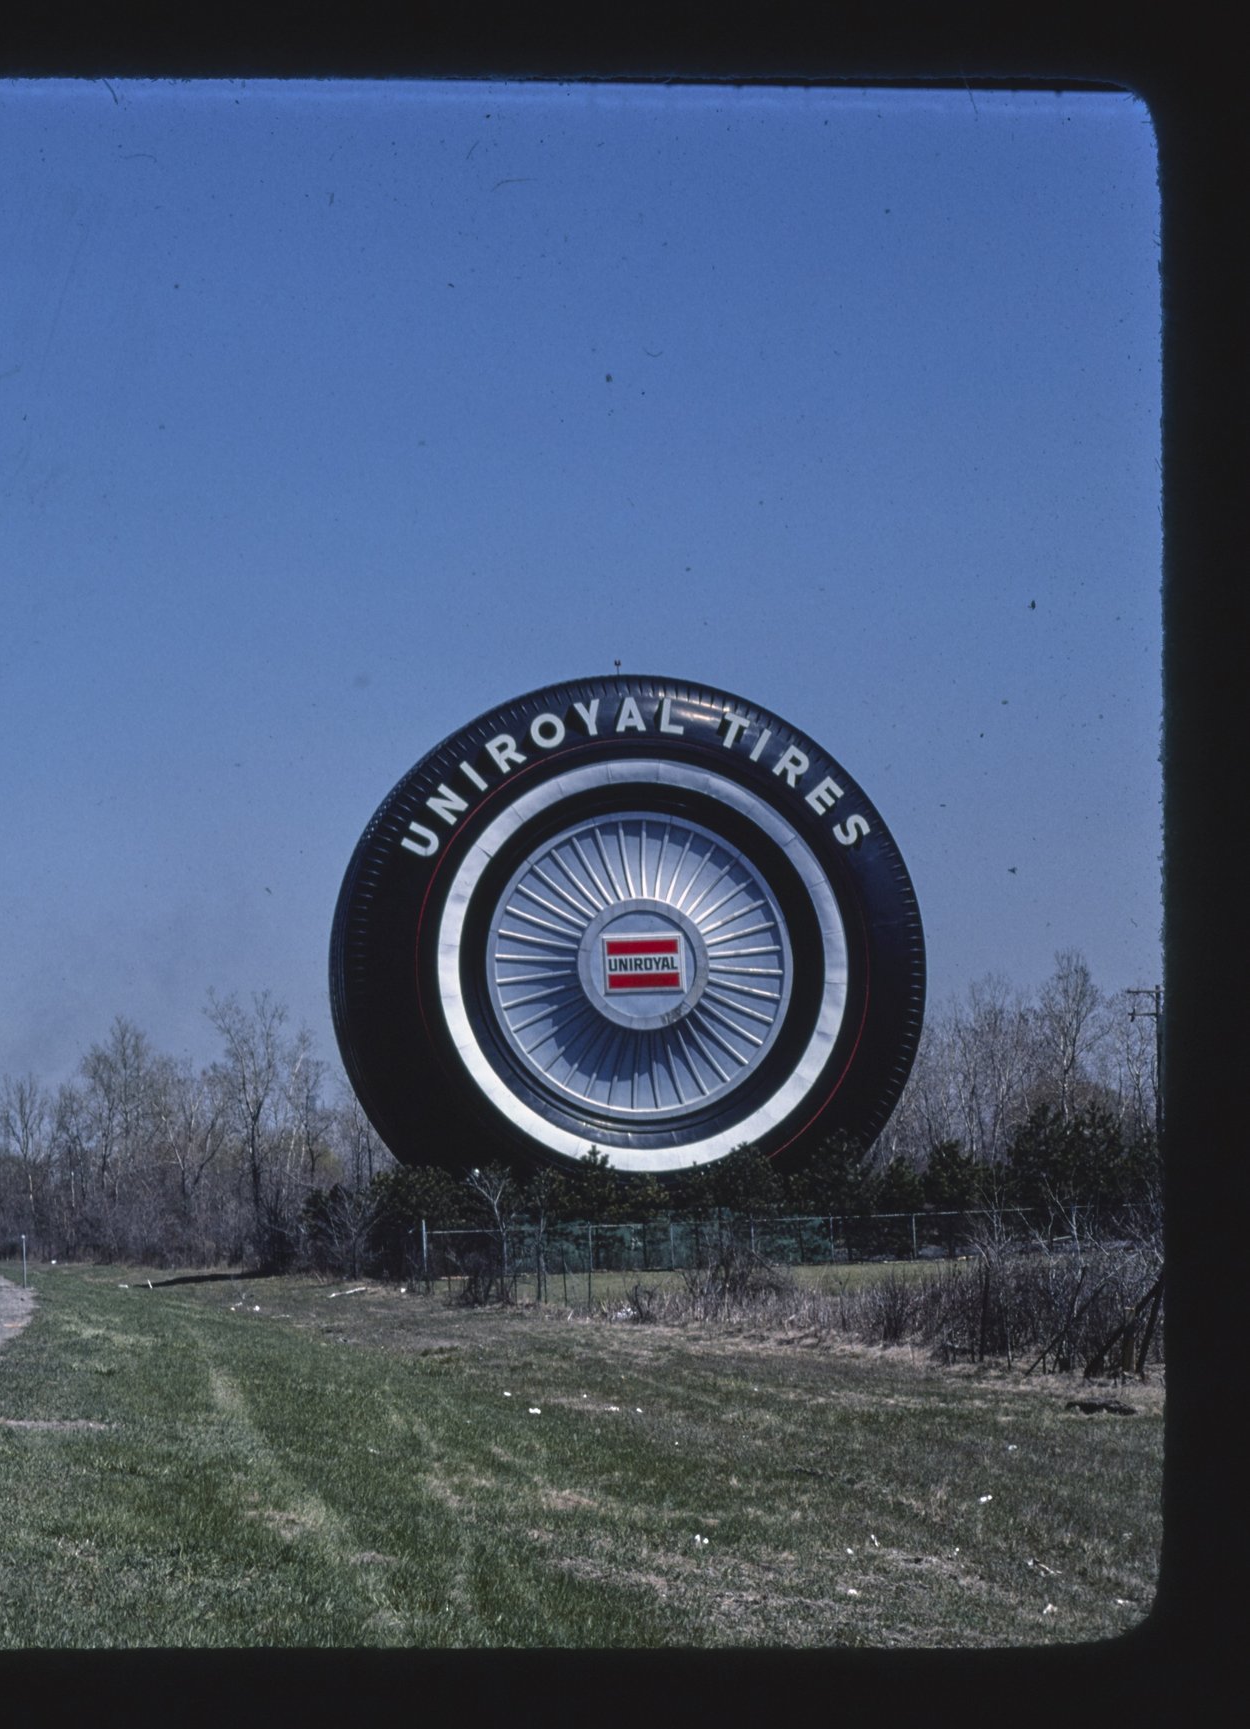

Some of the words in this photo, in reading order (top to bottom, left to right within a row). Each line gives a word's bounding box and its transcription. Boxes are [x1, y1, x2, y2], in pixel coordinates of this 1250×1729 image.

[400, 696, 685, 857] UNIROYAL
[721, 712, 871, 846] TIRES
[608, 956, 678, 972] UNIROYAL
